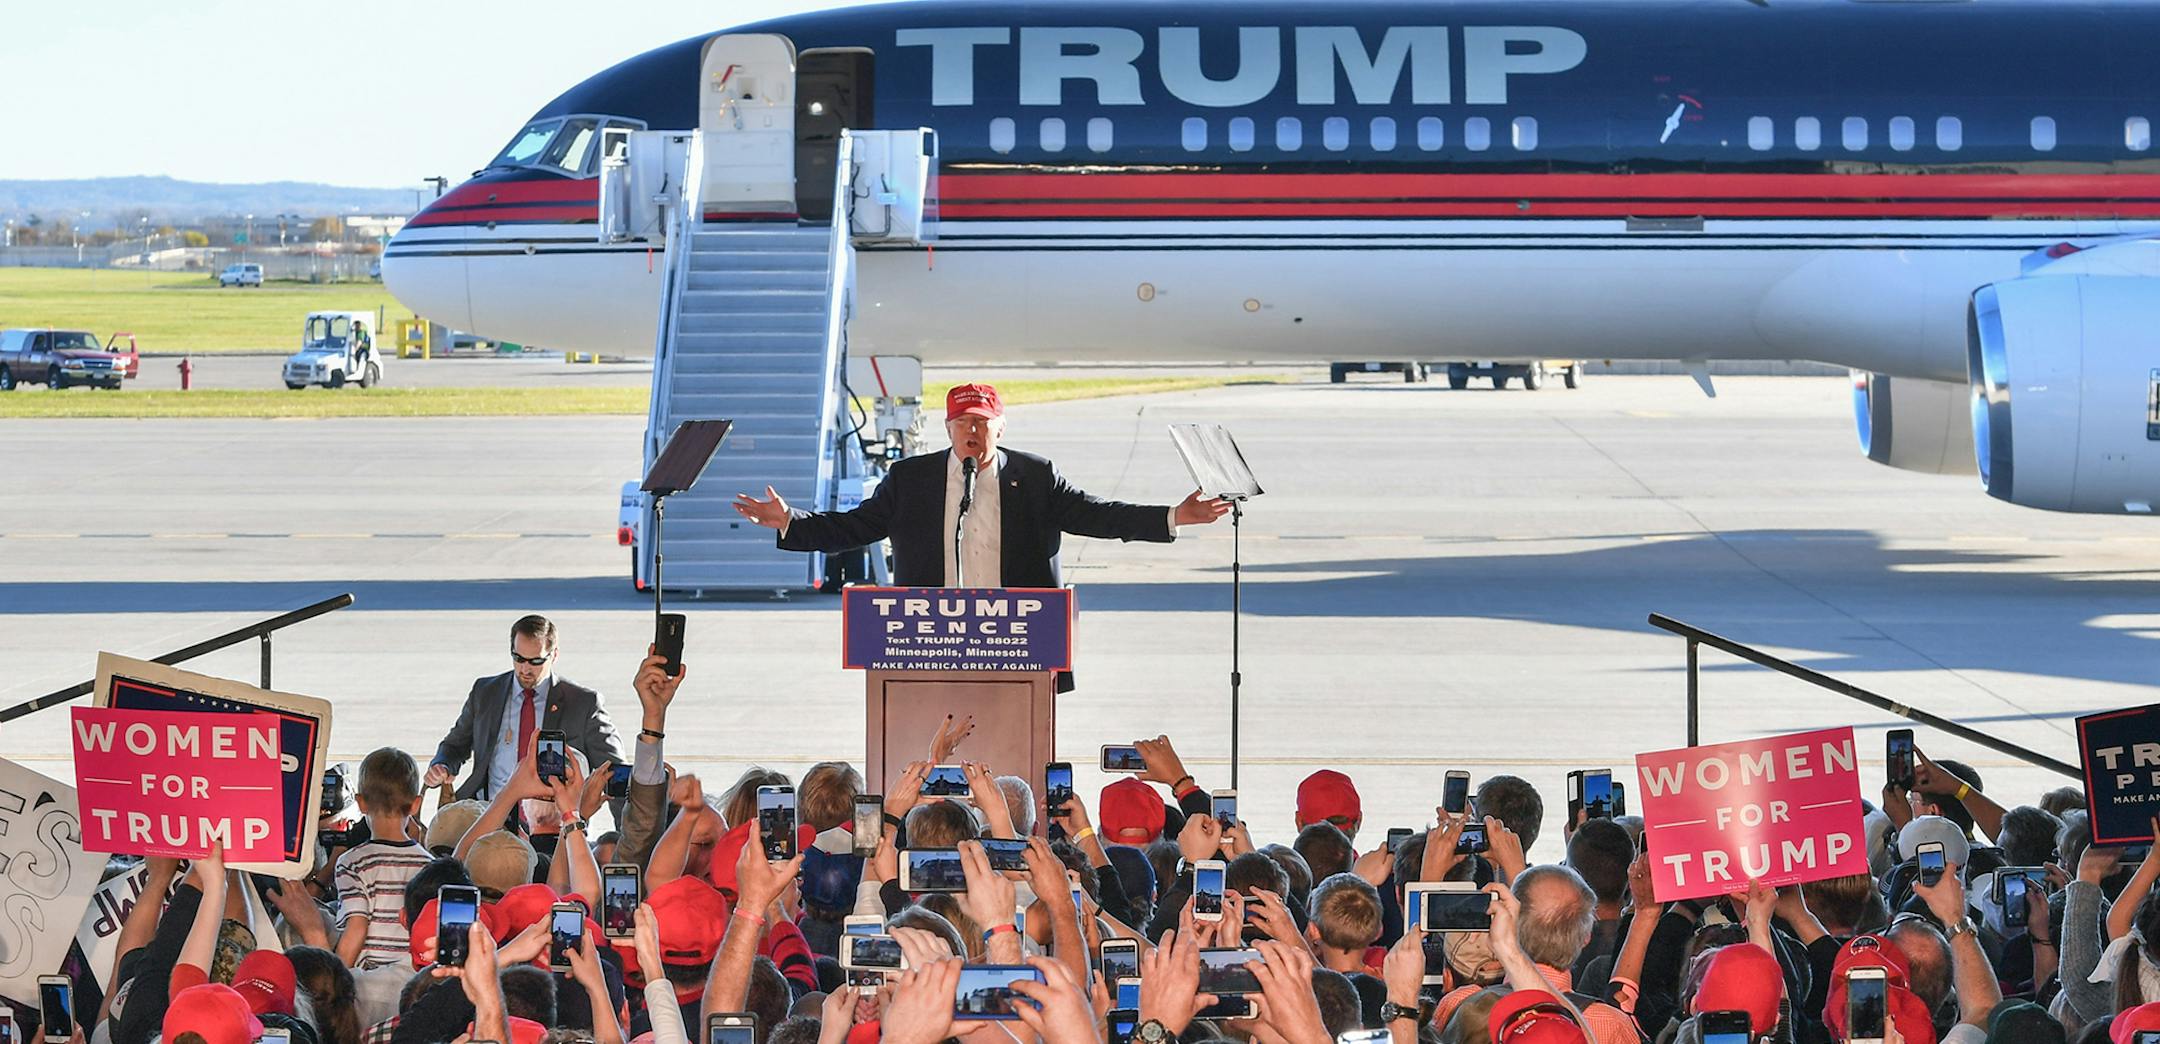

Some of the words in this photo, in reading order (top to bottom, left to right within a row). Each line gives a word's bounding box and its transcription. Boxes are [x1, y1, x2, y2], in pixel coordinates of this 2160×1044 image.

[895, 26, 1588, 107] TRUMP
[872, 598, 1042, 617] TRUMP
[886, 621, 1028, 634] PENCE
[886, 636, 910, 645] Text
[915, 636, 964, 645] TRUMP
[969, 637, 981, 645] to
[986, 637, 1028, 645] 88022
[885, 647, 962, 658] Minneapolis,
[966, 648, 1028, 658] Minnesota
[872, 662, 903, 670] MAKE
[907, 662, 958, 670] AMERICA
[961, 662, 998, 670] GREAT
[1002, 663, 1042, 671] AGAIN!
[75, 719, 279, 760] WOMEN
[1640, 740, 1855, 797] WOMEN
[141, 774, 210, 800] FOR
[2113, 794, 2144, 804] MAKE
[1716, 801, 1790, 830] FOR
[92, 808, 270, 850] TRUMP
[1663, 832, 1852, 887] TRUMP
